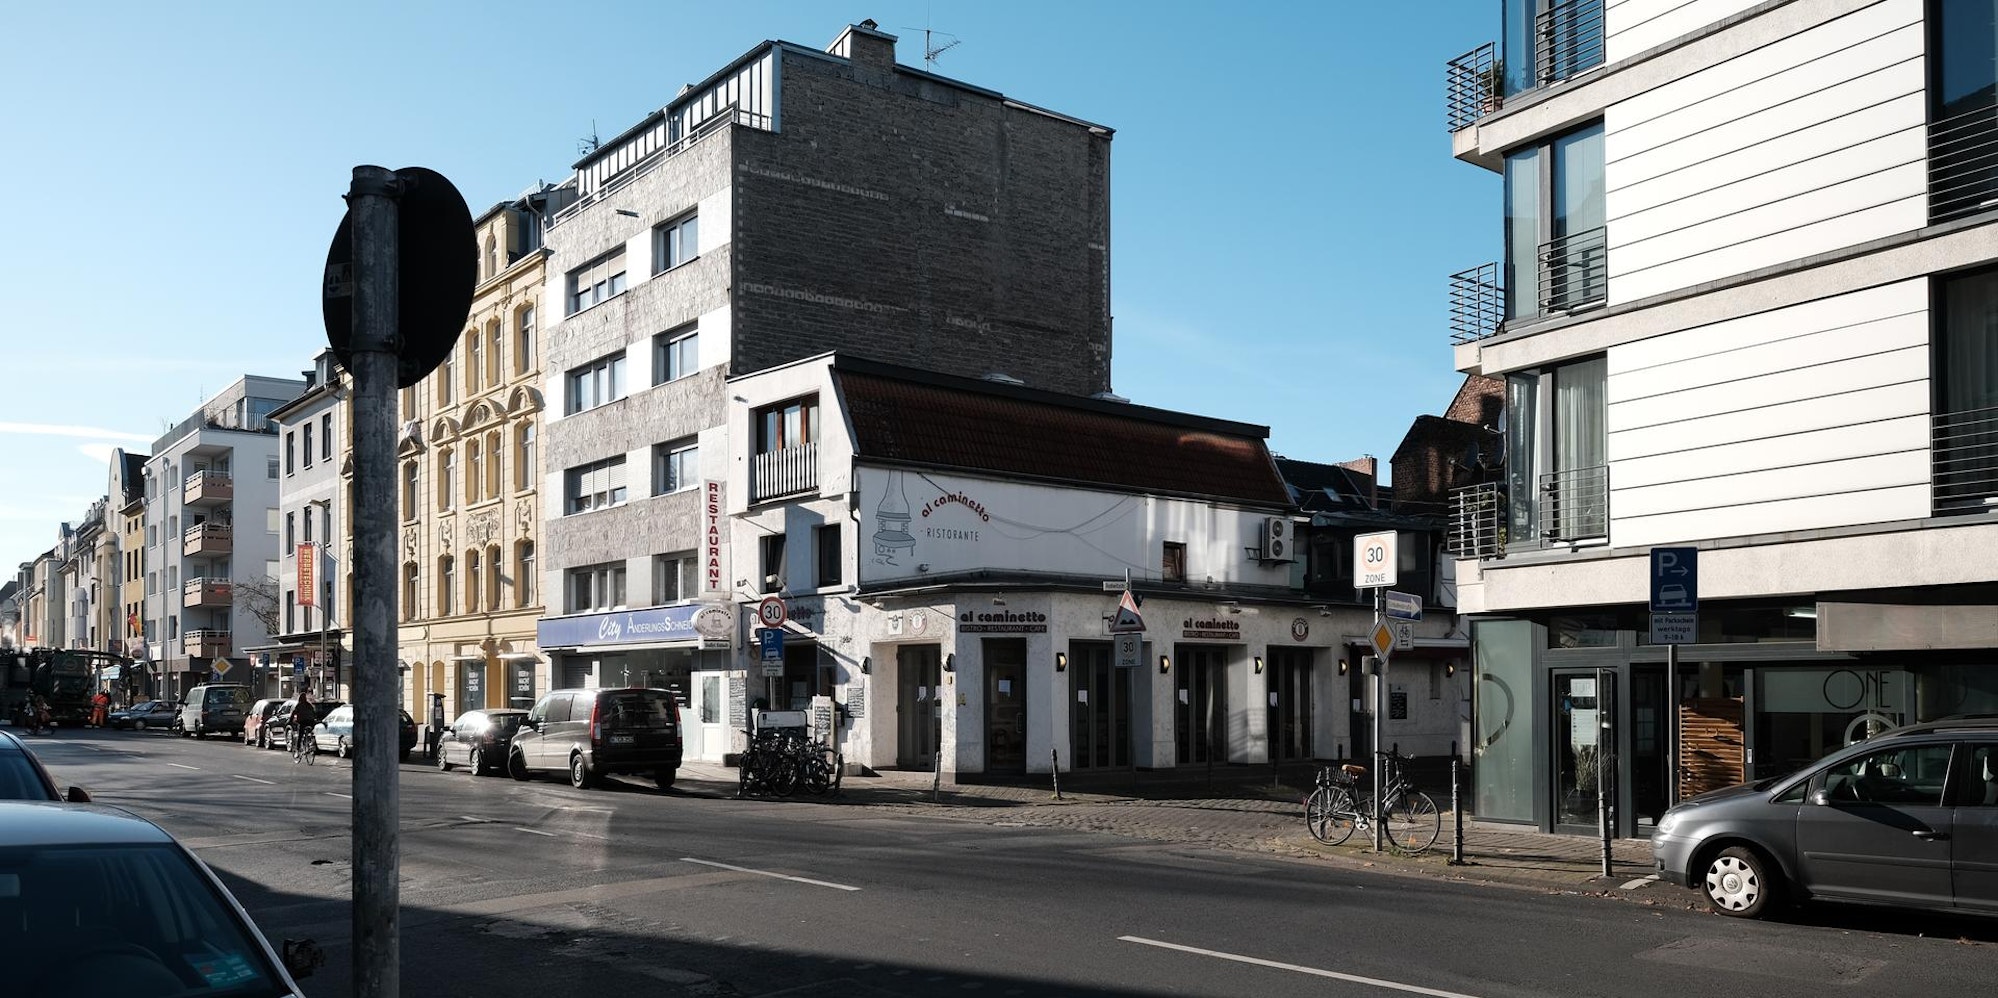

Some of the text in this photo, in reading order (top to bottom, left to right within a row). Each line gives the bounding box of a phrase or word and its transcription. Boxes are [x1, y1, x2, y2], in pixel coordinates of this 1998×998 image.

[922, 491, 989, 522] al caminetto
[709, 483, 719, 589] RESTAURANT
[927, 527, 979, 542] RISTORANTE
[1367, 546, 1383, 563] 30
[1658, 552, 1678, 577] P
[1365, 573, 1386, 583] ZONE
[764, 605, 781, 620] 30
[960, 609, 1046, 622] al caminetto
[599, 616, 621, 640] City
[627, 613, 694, 634] ÄNDERUNGSSCHNEID
[1183, 617, 1240, 630] al caminetto
[764, 631, 774, 644] P
[1123, 642, 1134, 653] 30
[1823, 669, 1891, 710] ONE
